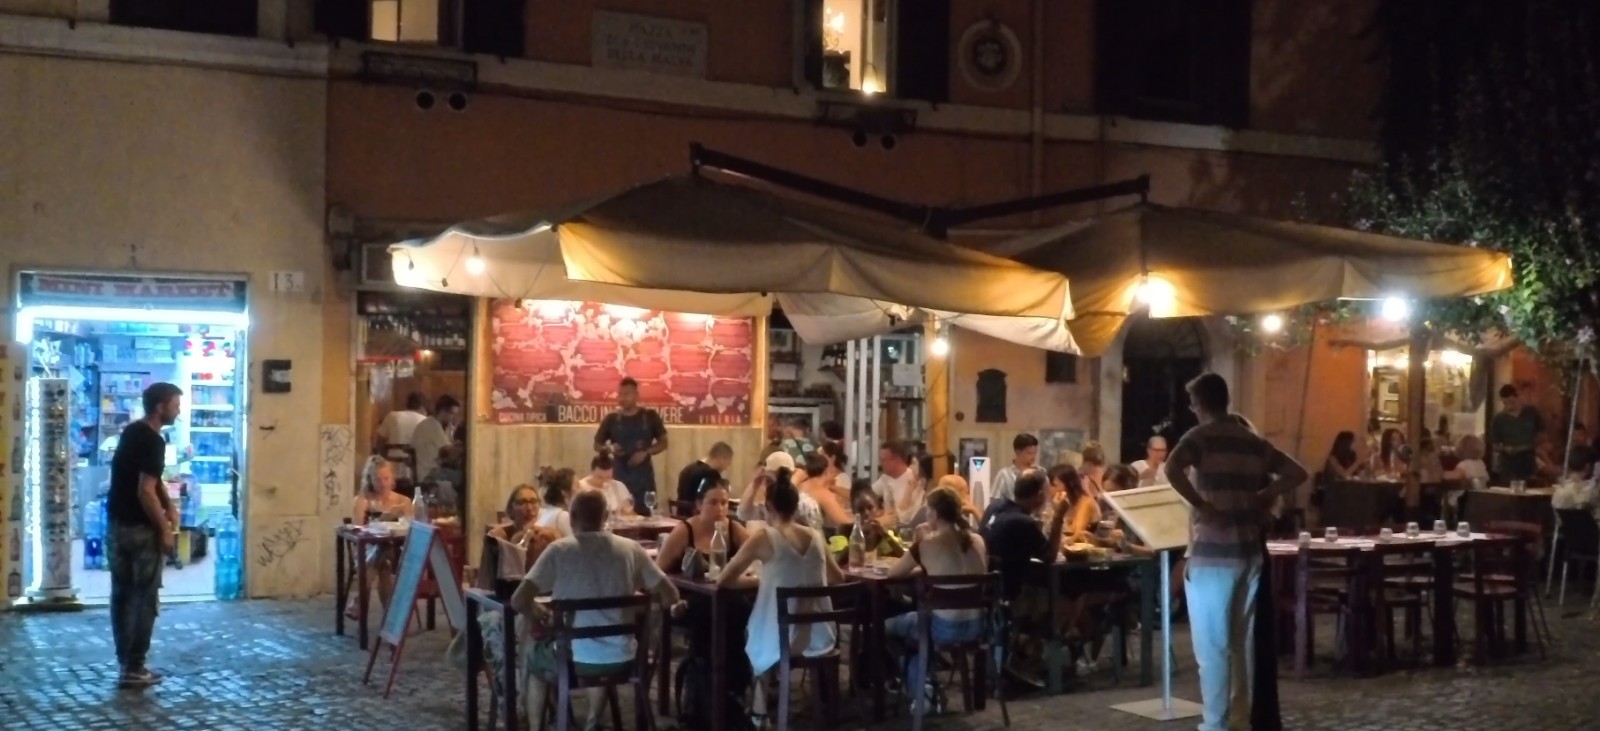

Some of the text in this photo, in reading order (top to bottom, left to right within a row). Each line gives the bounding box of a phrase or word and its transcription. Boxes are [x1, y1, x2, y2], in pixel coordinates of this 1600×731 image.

[38, 278, 233, 298] MINI MARKET
[558, 404, 596, 423] BACCO
[698, 414, 742, 425] VINERIA
